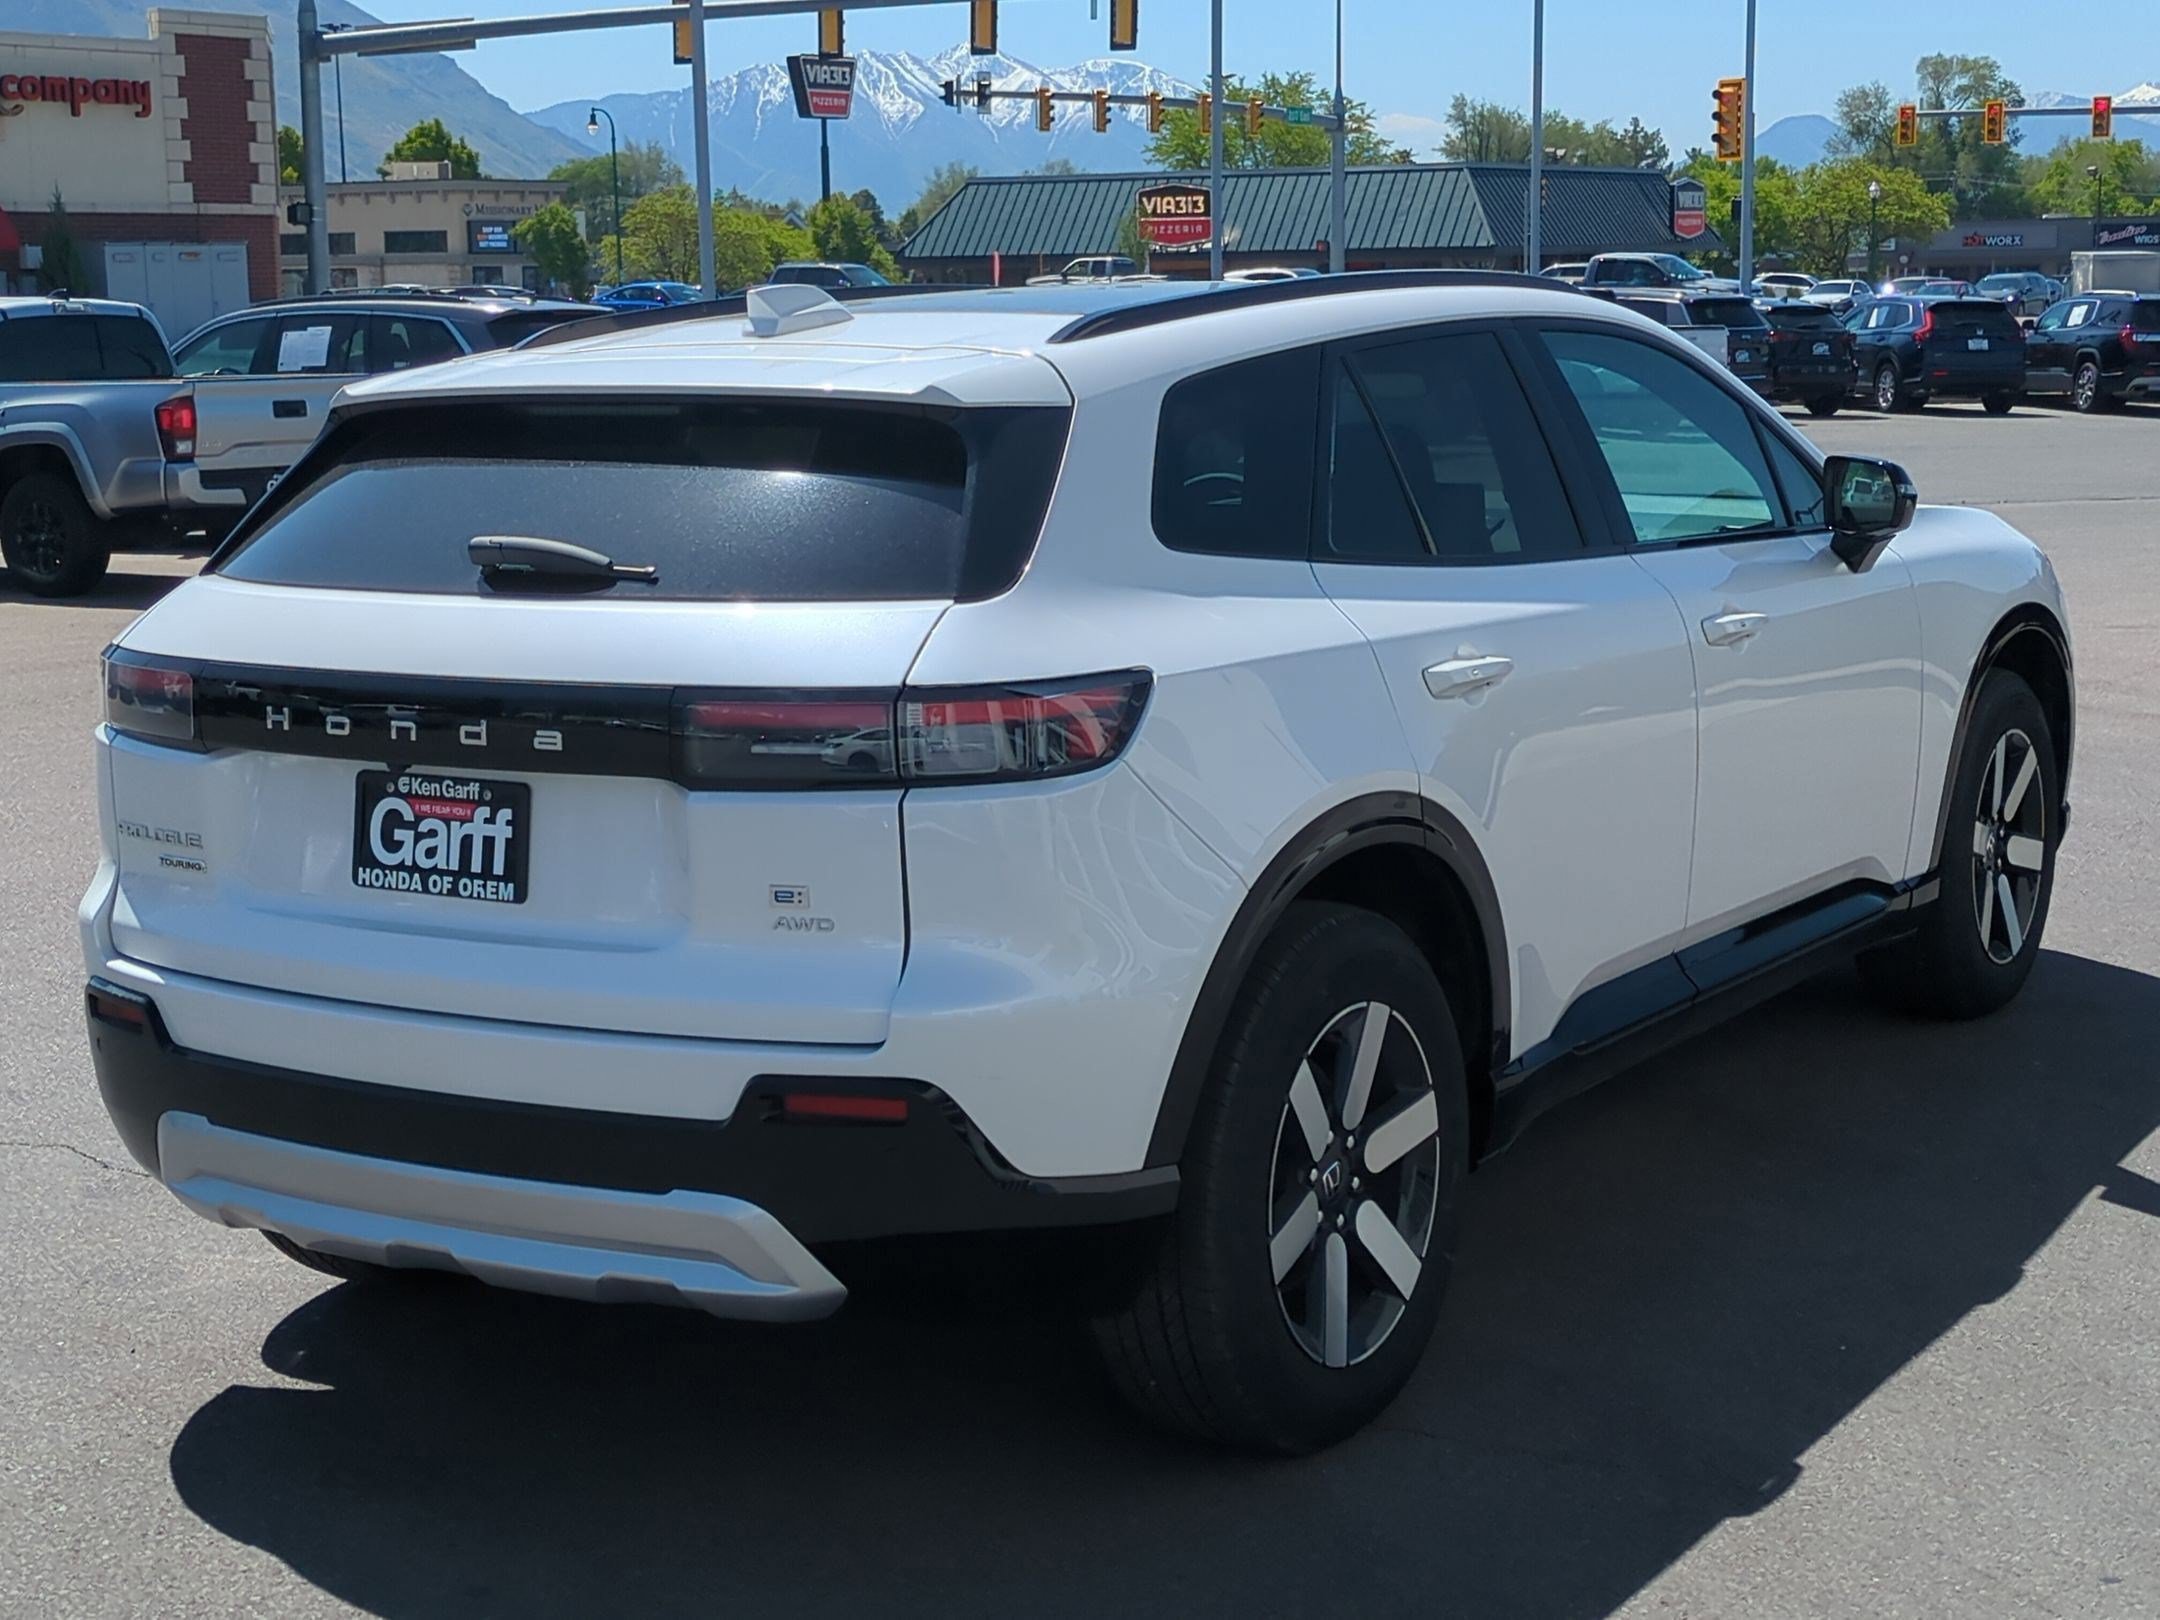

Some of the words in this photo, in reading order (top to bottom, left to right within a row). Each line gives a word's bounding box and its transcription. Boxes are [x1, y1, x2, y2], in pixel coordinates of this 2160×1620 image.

[806, 64, 851, 86] VIA313
[0, 74, 152, 118] company
[1142, 195, 1205, 214] VIA313
[411, 776, 441, 798] Ken
[442, 779, 480, 800] Garff
[370, 797, 513, 876] Garff
[159, 856, 202, 871] TOURING
[357, 867, 423, 892] HONDA
[428, 875, 453, 895] OF
[458, 878, 515, 901] OREM
[773, 916, 836, 932] AWD
